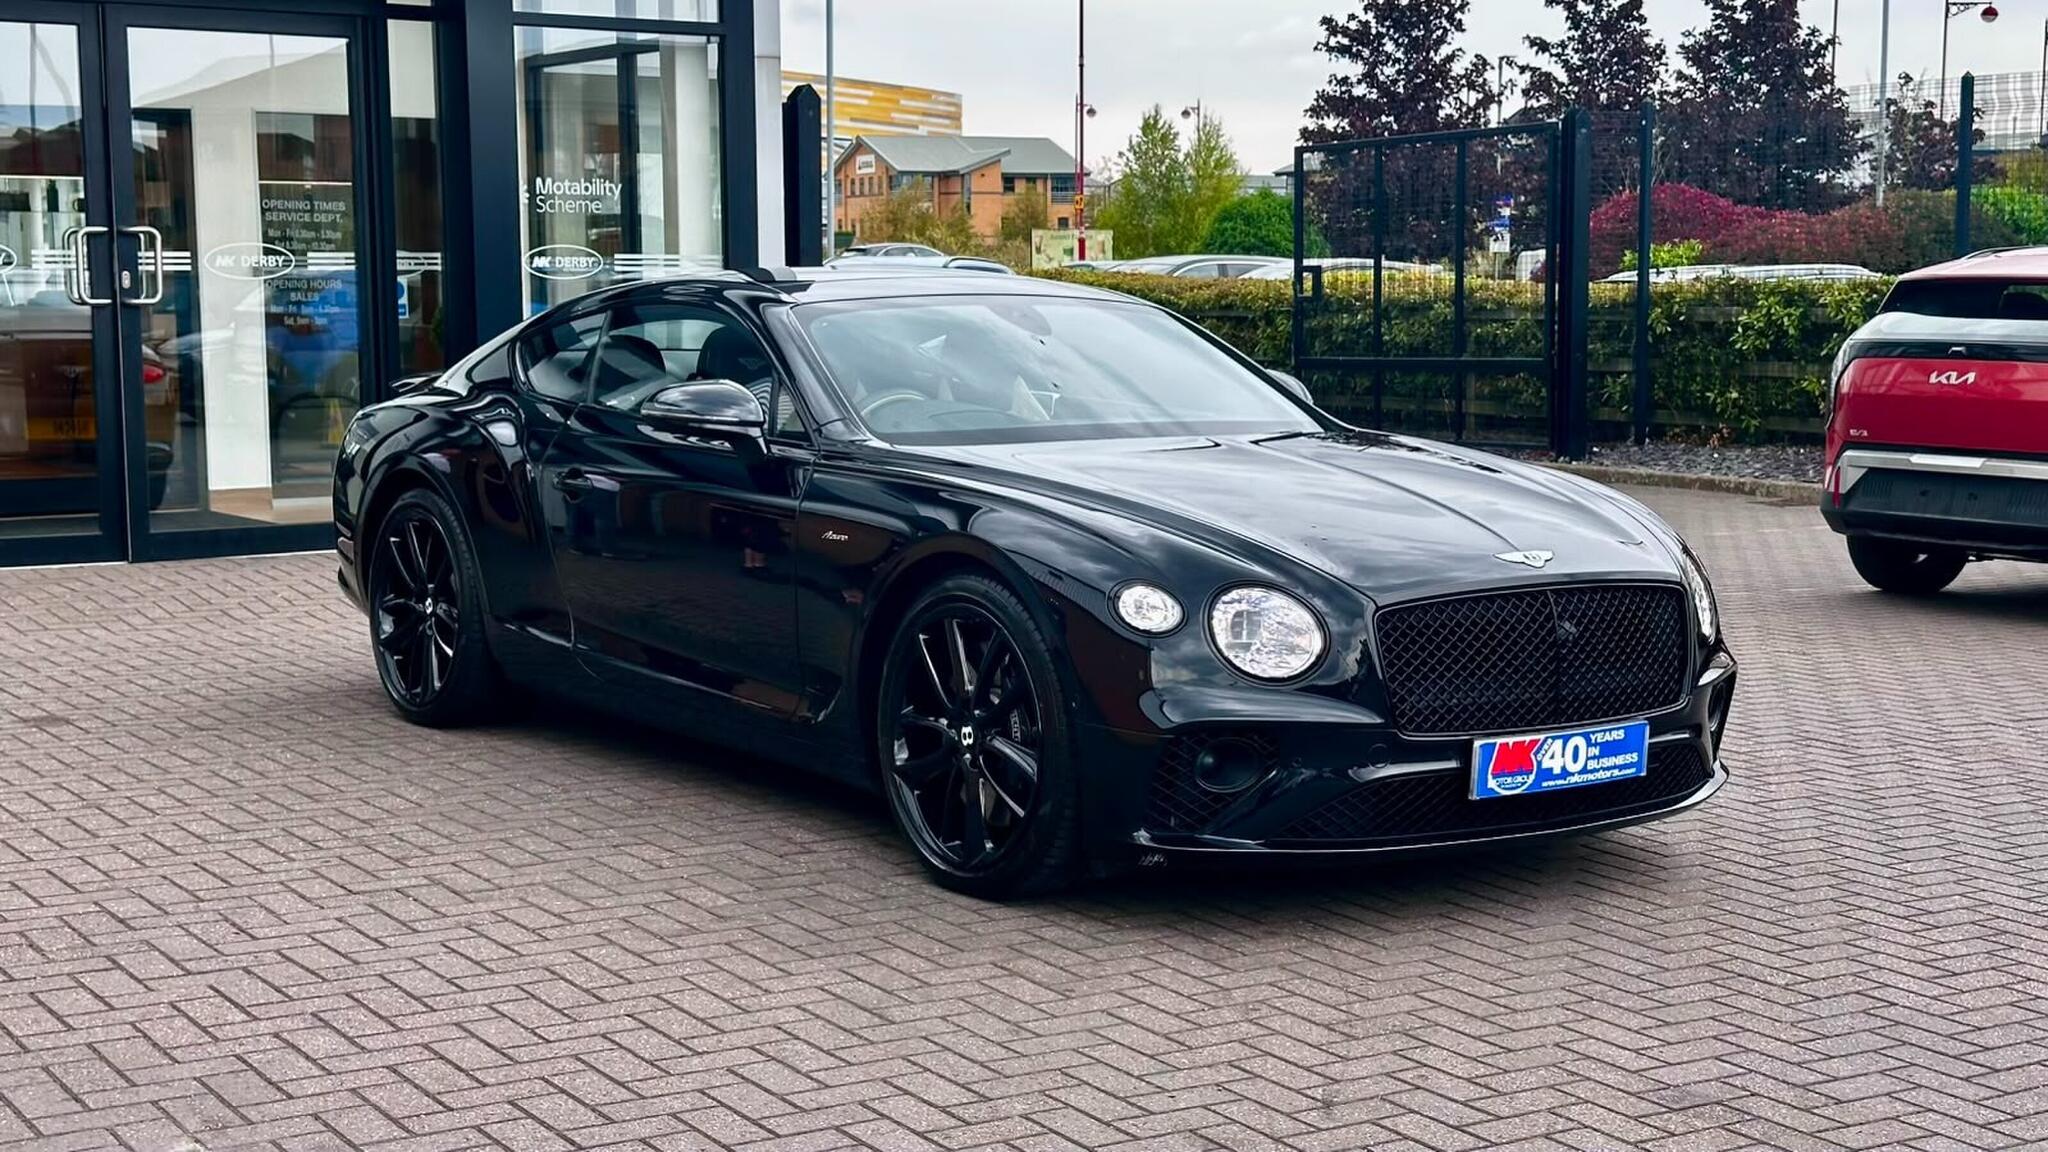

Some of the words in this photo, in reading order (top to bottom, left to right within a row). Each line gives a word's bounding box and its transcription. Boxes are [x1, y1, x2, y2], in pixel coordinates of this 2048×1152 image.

[535, 177, 622, 200] Motability
[262, 199, 311, 211] OPENING
[313, 200, 346, 211] TIMES
[536, 196, 602, 213] Scheme
[265, 211, 311, 222] SERVICE
[313, 212, 343, 223] DEPT.
[241, 256, 285, 268] DERBY
[555, 256, 595, 268] DERBY
[266, 279, 307, 289] OPENING
[310, 279, 342, 289] HOURS
[290, 292, 319, 302] SALES
[1929, 370, 1976, 385] KIA
[961, 725, 974, 746] B
[1590, 729, 1625, 744] YEARS
[1491, 737, 1541, 775] NK
[1536, 738, 1553, 761] OVER
[1541, 736, 1587, 774] 40
[1588, 746, 1599, 757] IN
[1587, 752, 1638, 770] BUSINESS
[1541, 767, 1637, 788] www.nkmotors.com
